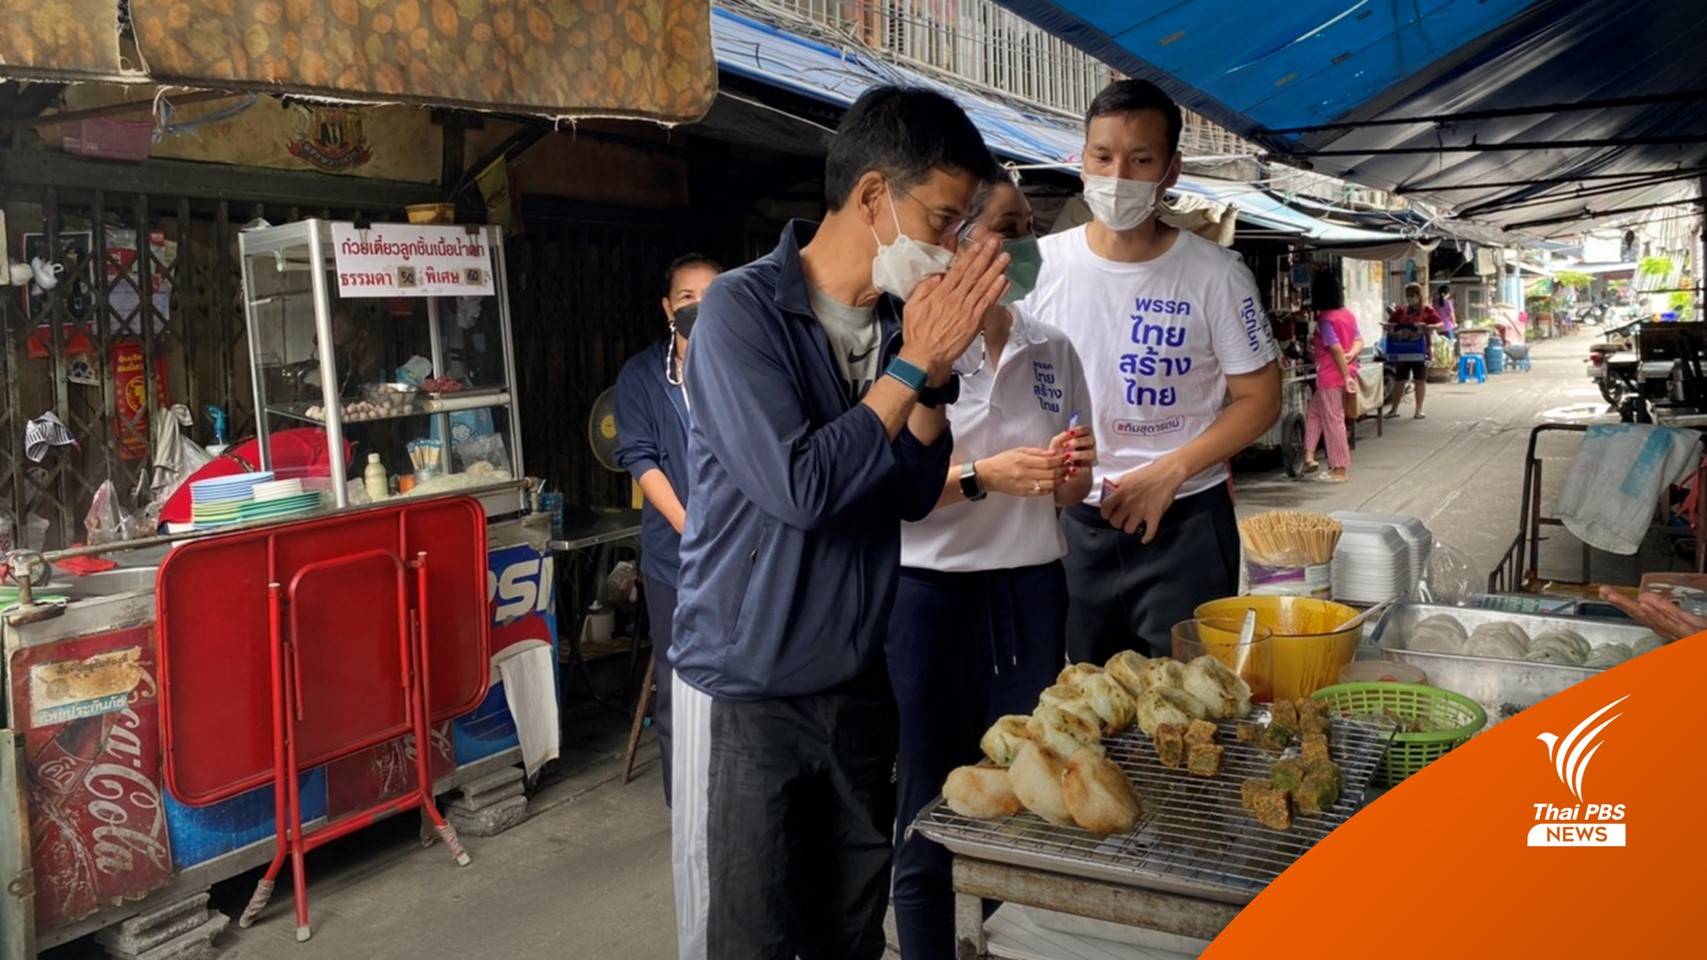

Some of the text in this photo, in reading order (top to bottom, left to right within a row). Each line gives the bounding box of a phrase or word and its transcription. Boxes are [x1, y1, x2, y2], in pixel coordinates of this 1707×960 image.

[340, 270, 393, 287] ธรรมดา
[425, 266, 460, 284] พิเศษ
[1135, 297, 1191, 316] พรรค
[1130, 314, 1186, 348] ไทย
[1241, 296, 1261, 352] ปทุมวัน
[1119, 346, 1192, 377] สร้าง
[1033, 367, 1055, 384] ไทย
[1033, 383, 1063, 399] สร้าง
[1124, 377, 1177, 407] ไทย
[1037, 396, 1060, 413] ไทย
